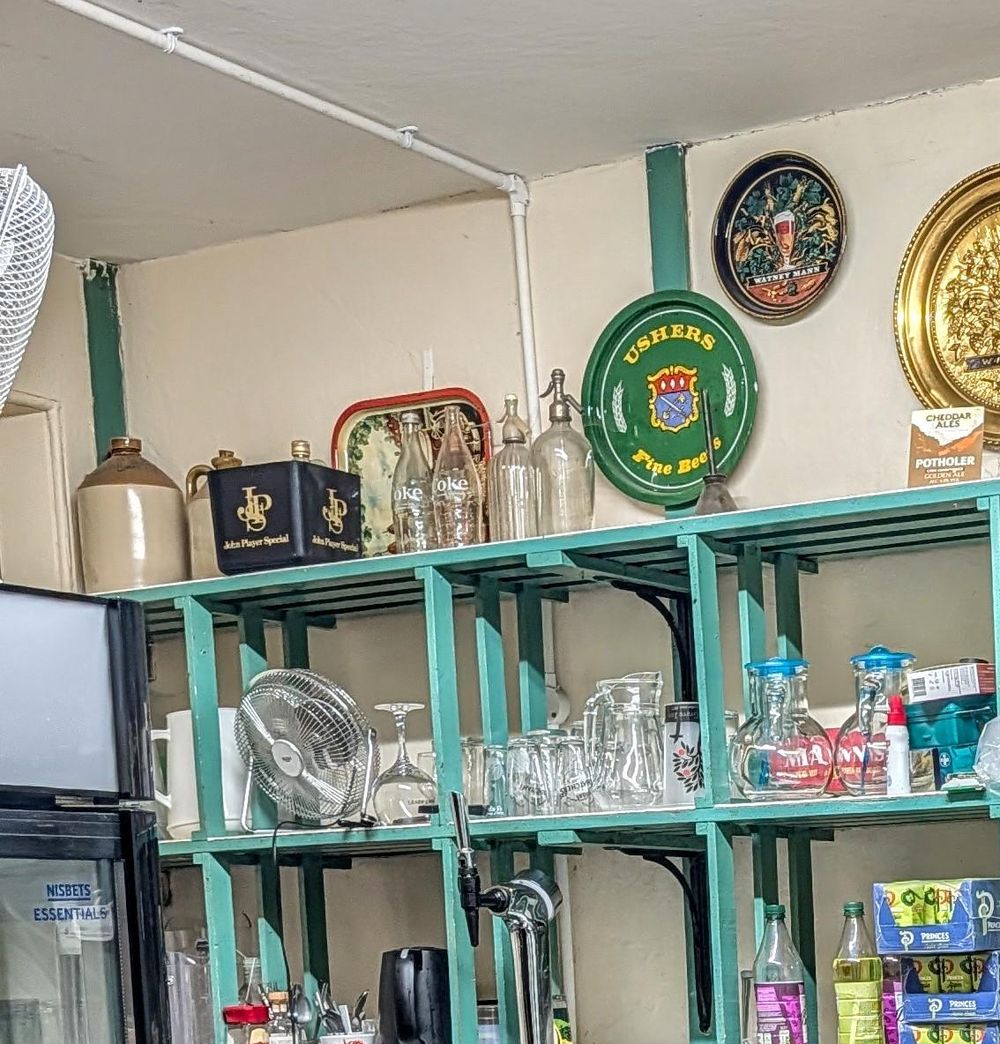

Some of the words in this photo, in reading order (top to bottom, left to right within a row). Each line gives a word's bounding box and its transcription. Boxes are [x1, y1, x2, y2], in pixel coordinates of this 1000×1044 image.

[754, 270, 789, 285] WATNEY
[792, 264, 820, 278] MANN
[623, 324, 716, 365] USHERS
[926, 412, 972, 422] CHEDDAR
[935, 420, 960, 429] ALES
[632, 448, 673, 476] Fine
[677, 437, 722, 474] Bees
[915, 455, 976, 469] POTHOLER
[223, 540, 241, 550] John
[242, 537, 263, 549] Player
[264, 534, 290, 546] Special
[46, 884, 91, 898] NISBETS
[34, 907, 108, 921] ESSENTIALS
[921, 932, 950, 940] PRINCES
[949, 1000, 976, 1008] PRINCES
